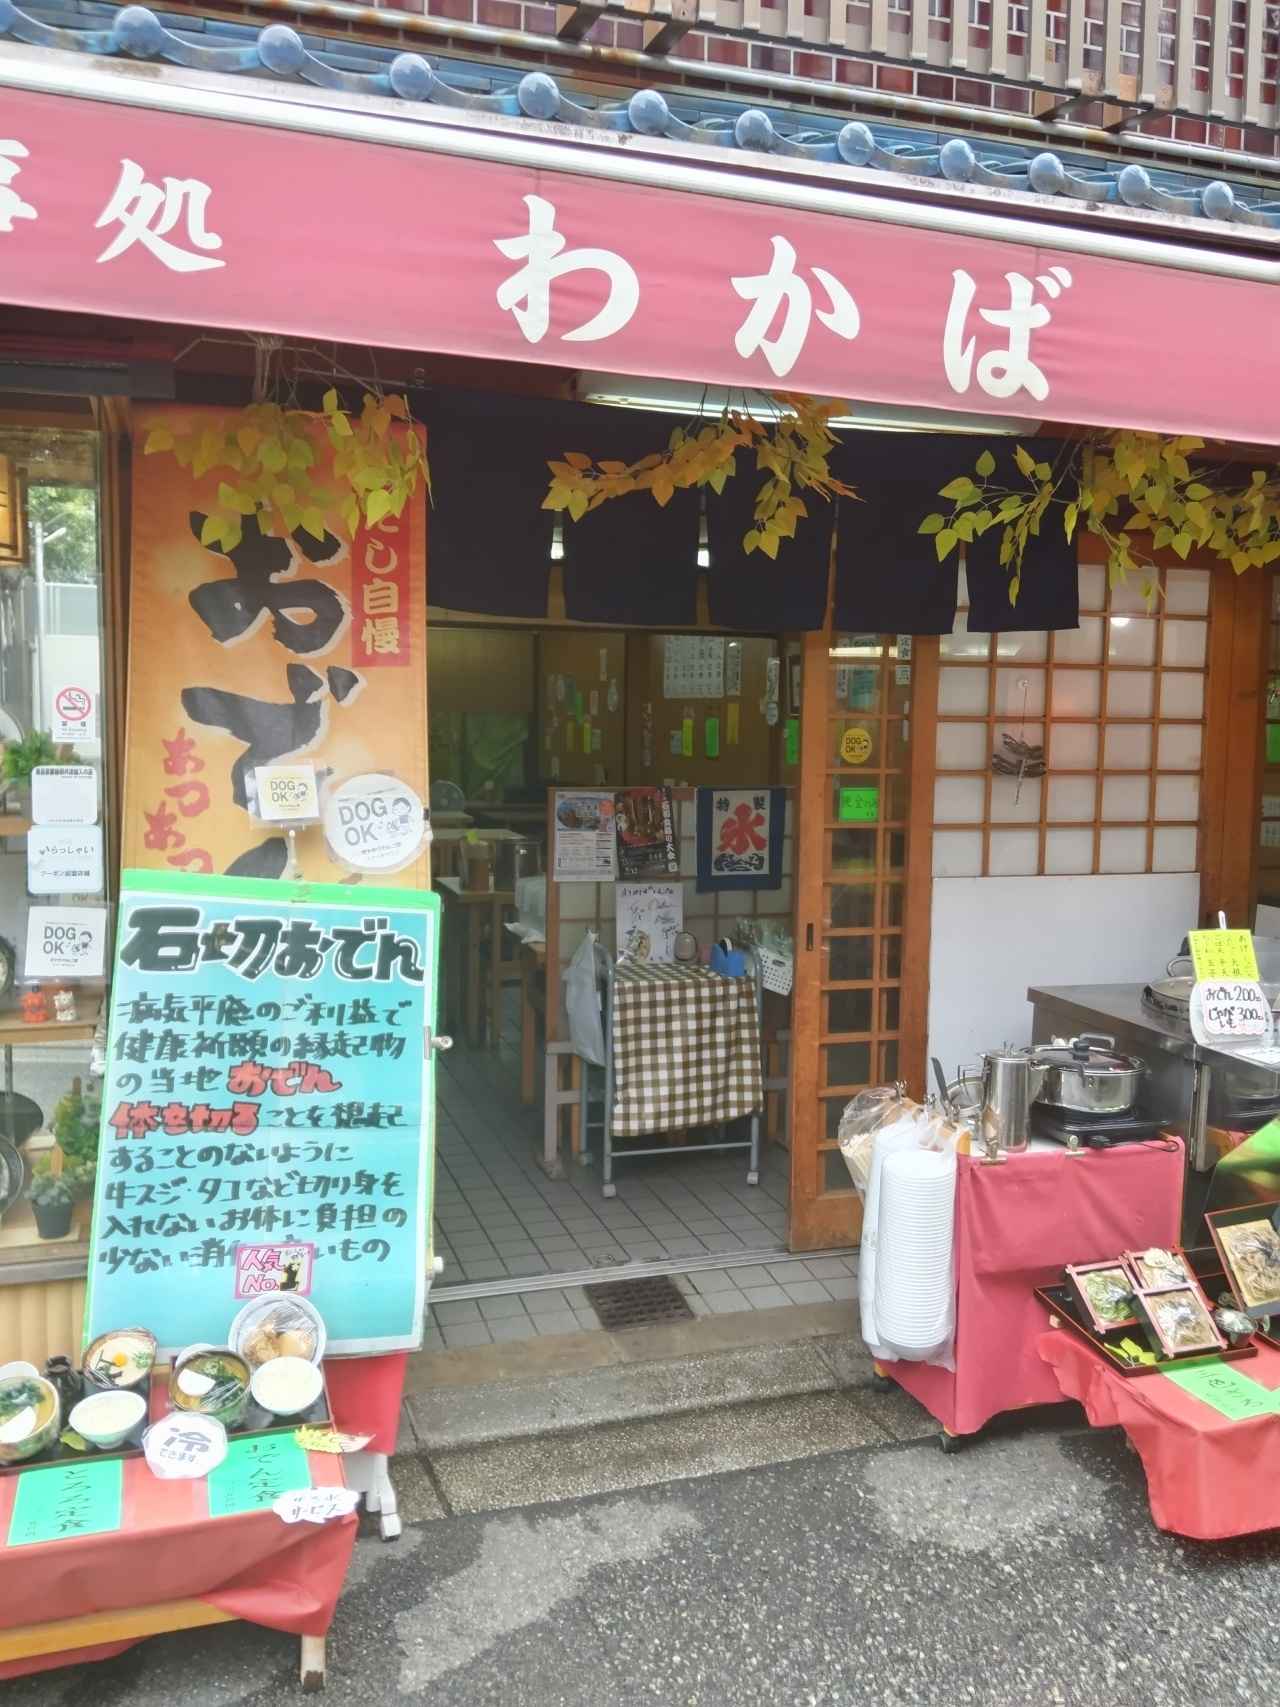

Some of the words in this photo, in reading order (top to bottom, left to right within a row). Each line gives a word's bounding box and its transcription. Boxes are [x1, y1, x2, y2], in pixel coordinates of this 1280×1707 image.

[492, 194, 1072, 401] わかば
[845, 736, 862, 746] DOG
[845, 745, 856, 754] OK
[270, 780, 296, 792] DOG
[271, 791, 289, 803] OK
[339, 797, 388, 826] DOG
[344, 821, 379, 847] OK
[717, 803, 766, 855] 氷
[43, 926, 77, 940] DOG
[120, 907, 425, 981] 石切おでん
[43, 941, 64, 955] OK
[114, 1028, 407, 1061] 健康祈願の縁起物
[108, 1142, 354, 1174] することのないように
[240, 1248, 282, 1273] 人気
